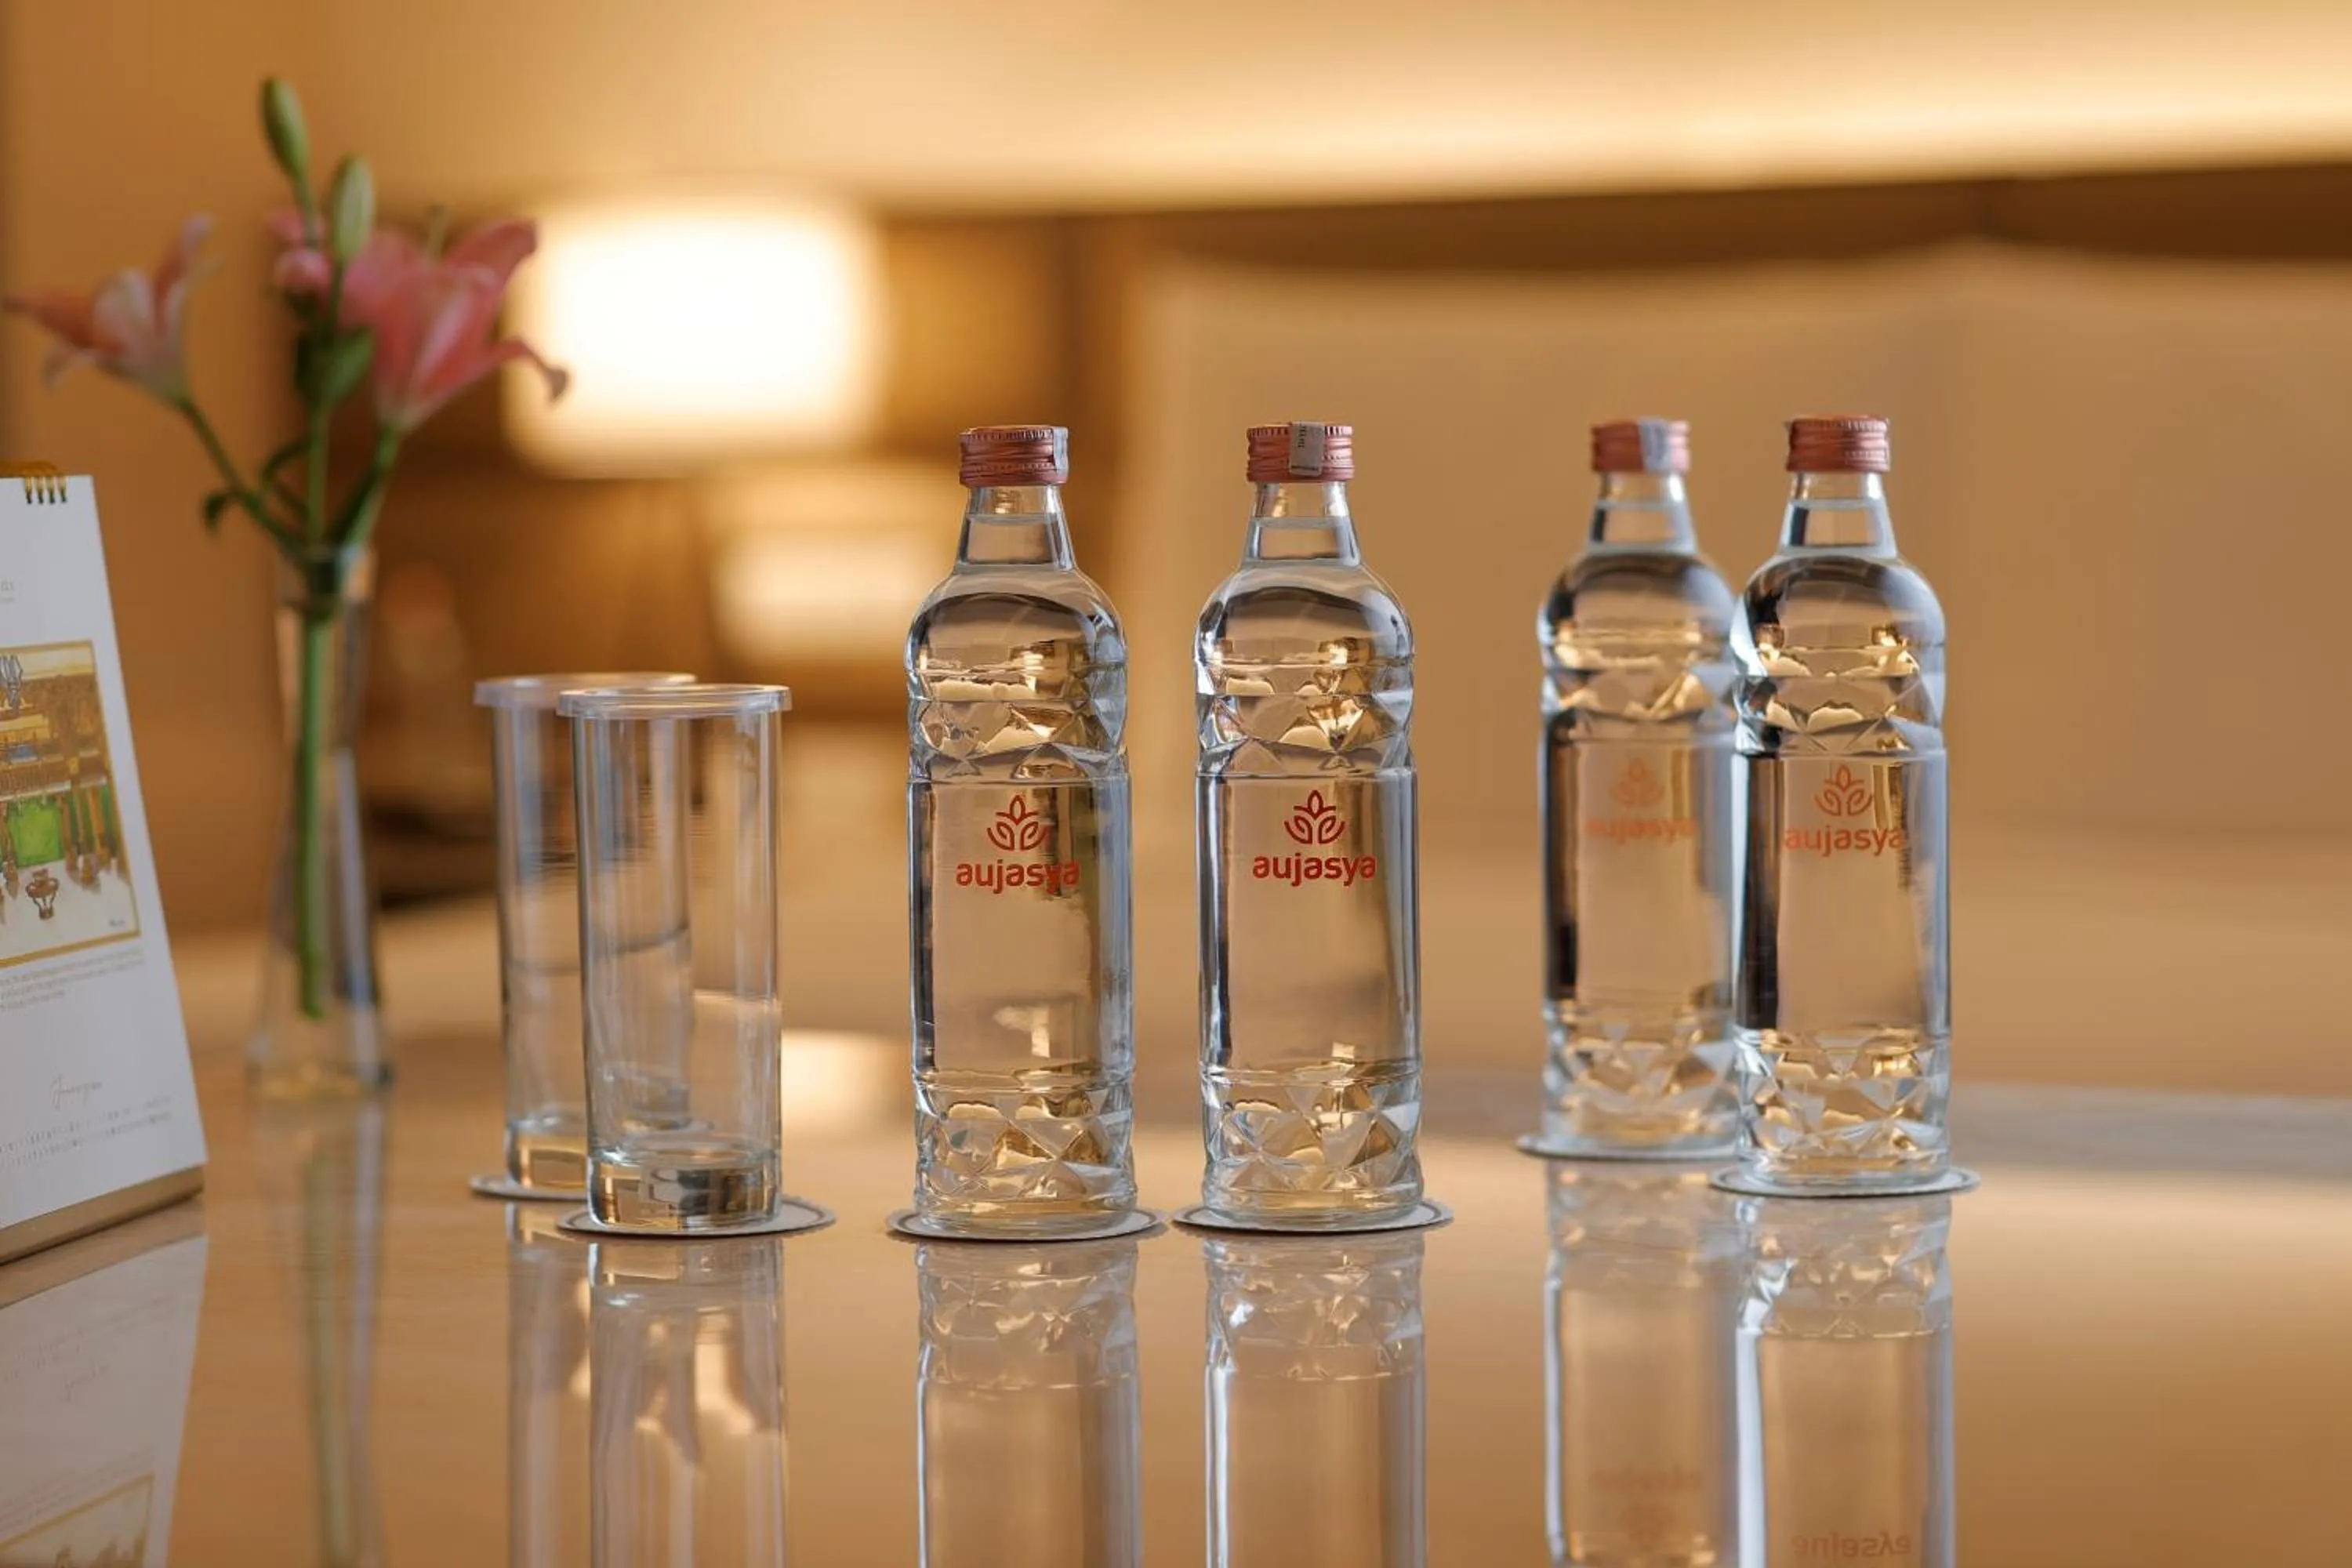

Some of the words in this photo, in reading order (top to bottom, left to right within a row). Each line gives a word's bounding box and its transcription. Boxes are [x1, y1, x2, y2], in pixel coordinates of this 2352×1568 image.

[1785, 826, 1905, 857] aujasya
[956, 858, 1080, 894] aujasya
[1253, 852, 1375, 886] aujasya
